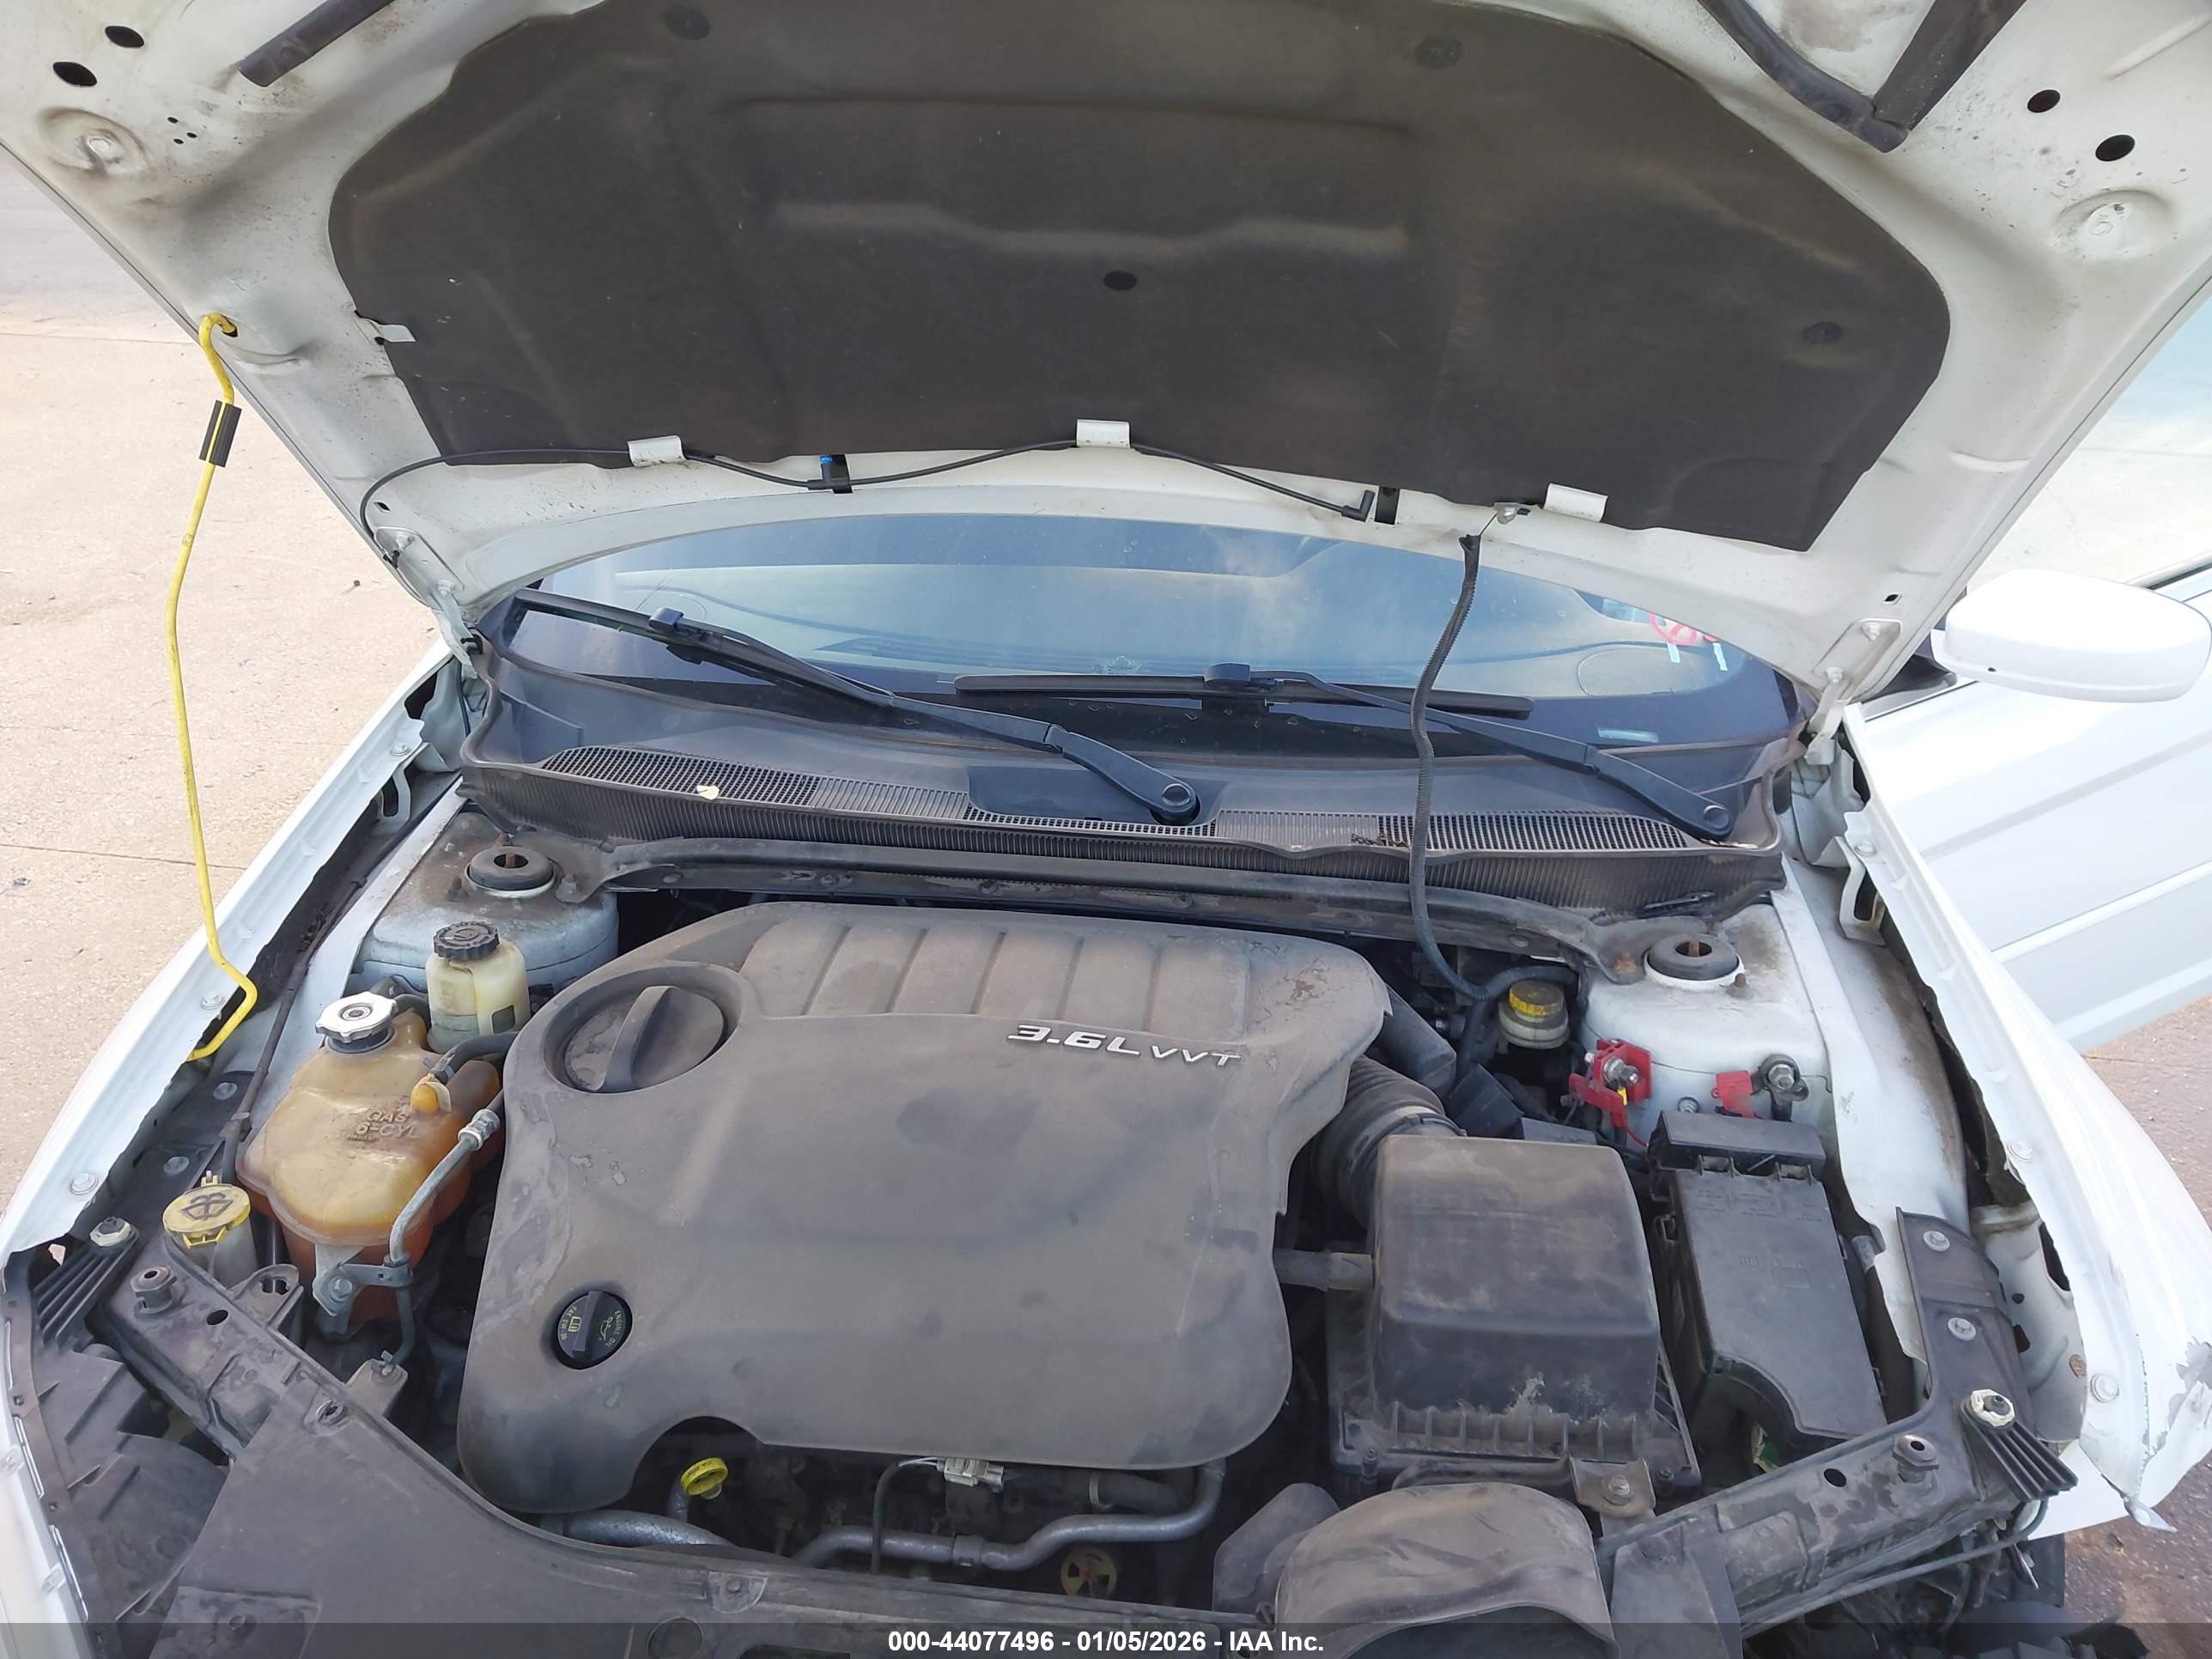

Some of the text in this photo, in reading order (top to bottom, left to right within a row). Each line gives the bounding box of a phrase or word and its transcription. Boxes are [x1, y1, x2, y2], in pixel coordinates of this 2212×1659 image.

[1007, 1024, 1243, 1066] 3.6L VVT
[368, 1109, 410, 1123] GAS
[356, 1121, 419, 1139] 6-CYL
[605, 1310, 623, 1347] ENGINE OIL
